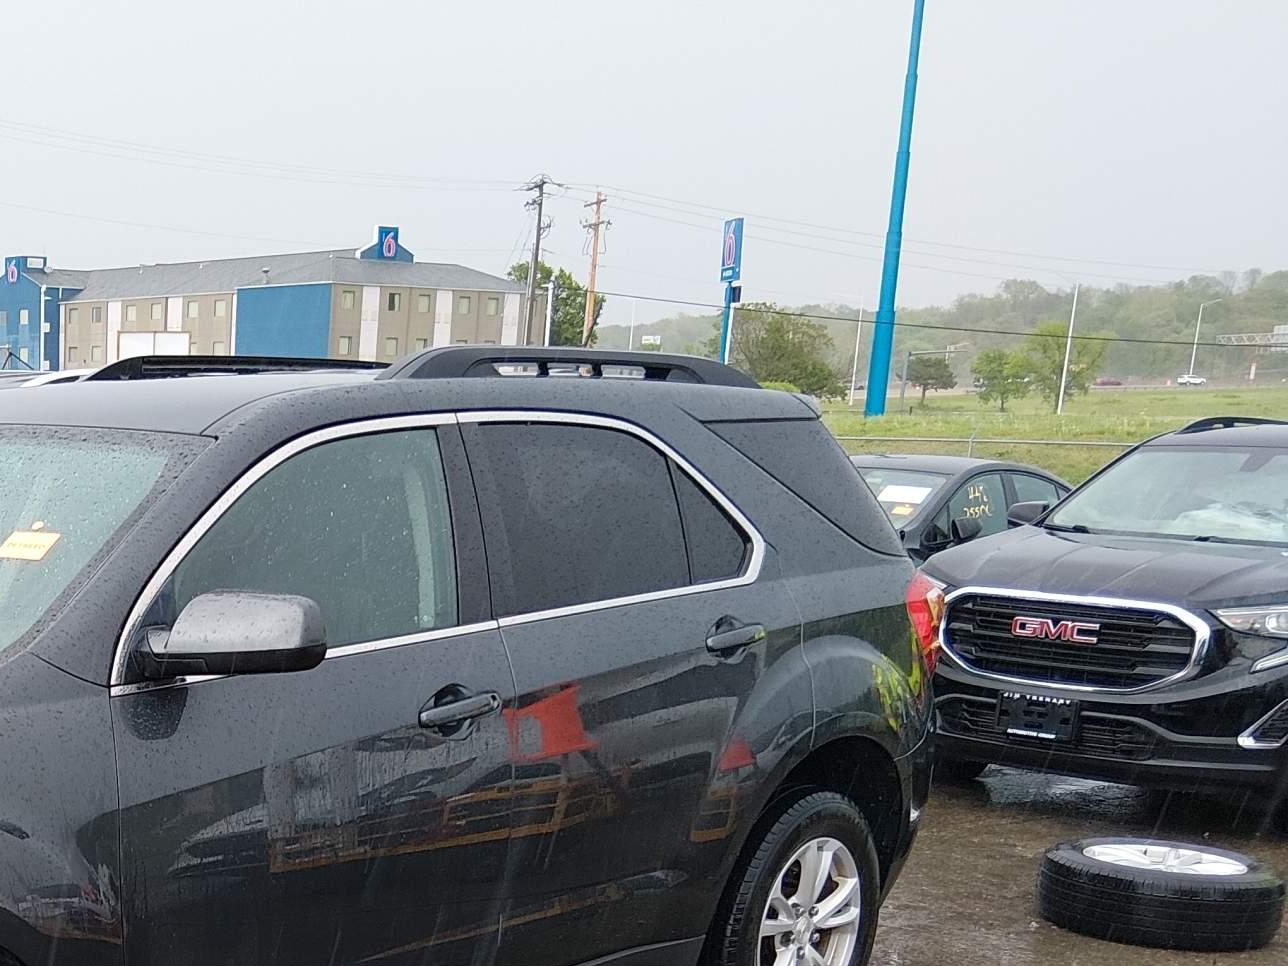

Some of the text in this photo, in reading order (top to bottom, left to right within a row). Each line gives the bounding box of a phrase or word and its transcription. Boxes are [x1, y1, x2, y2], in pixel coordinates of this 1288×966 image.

[383, 232, 396, 257] 6
[724, 221, 736, 267] 6
[7, 259, 18, 283] 6
[1011, 616, 1101, 644] GMC
